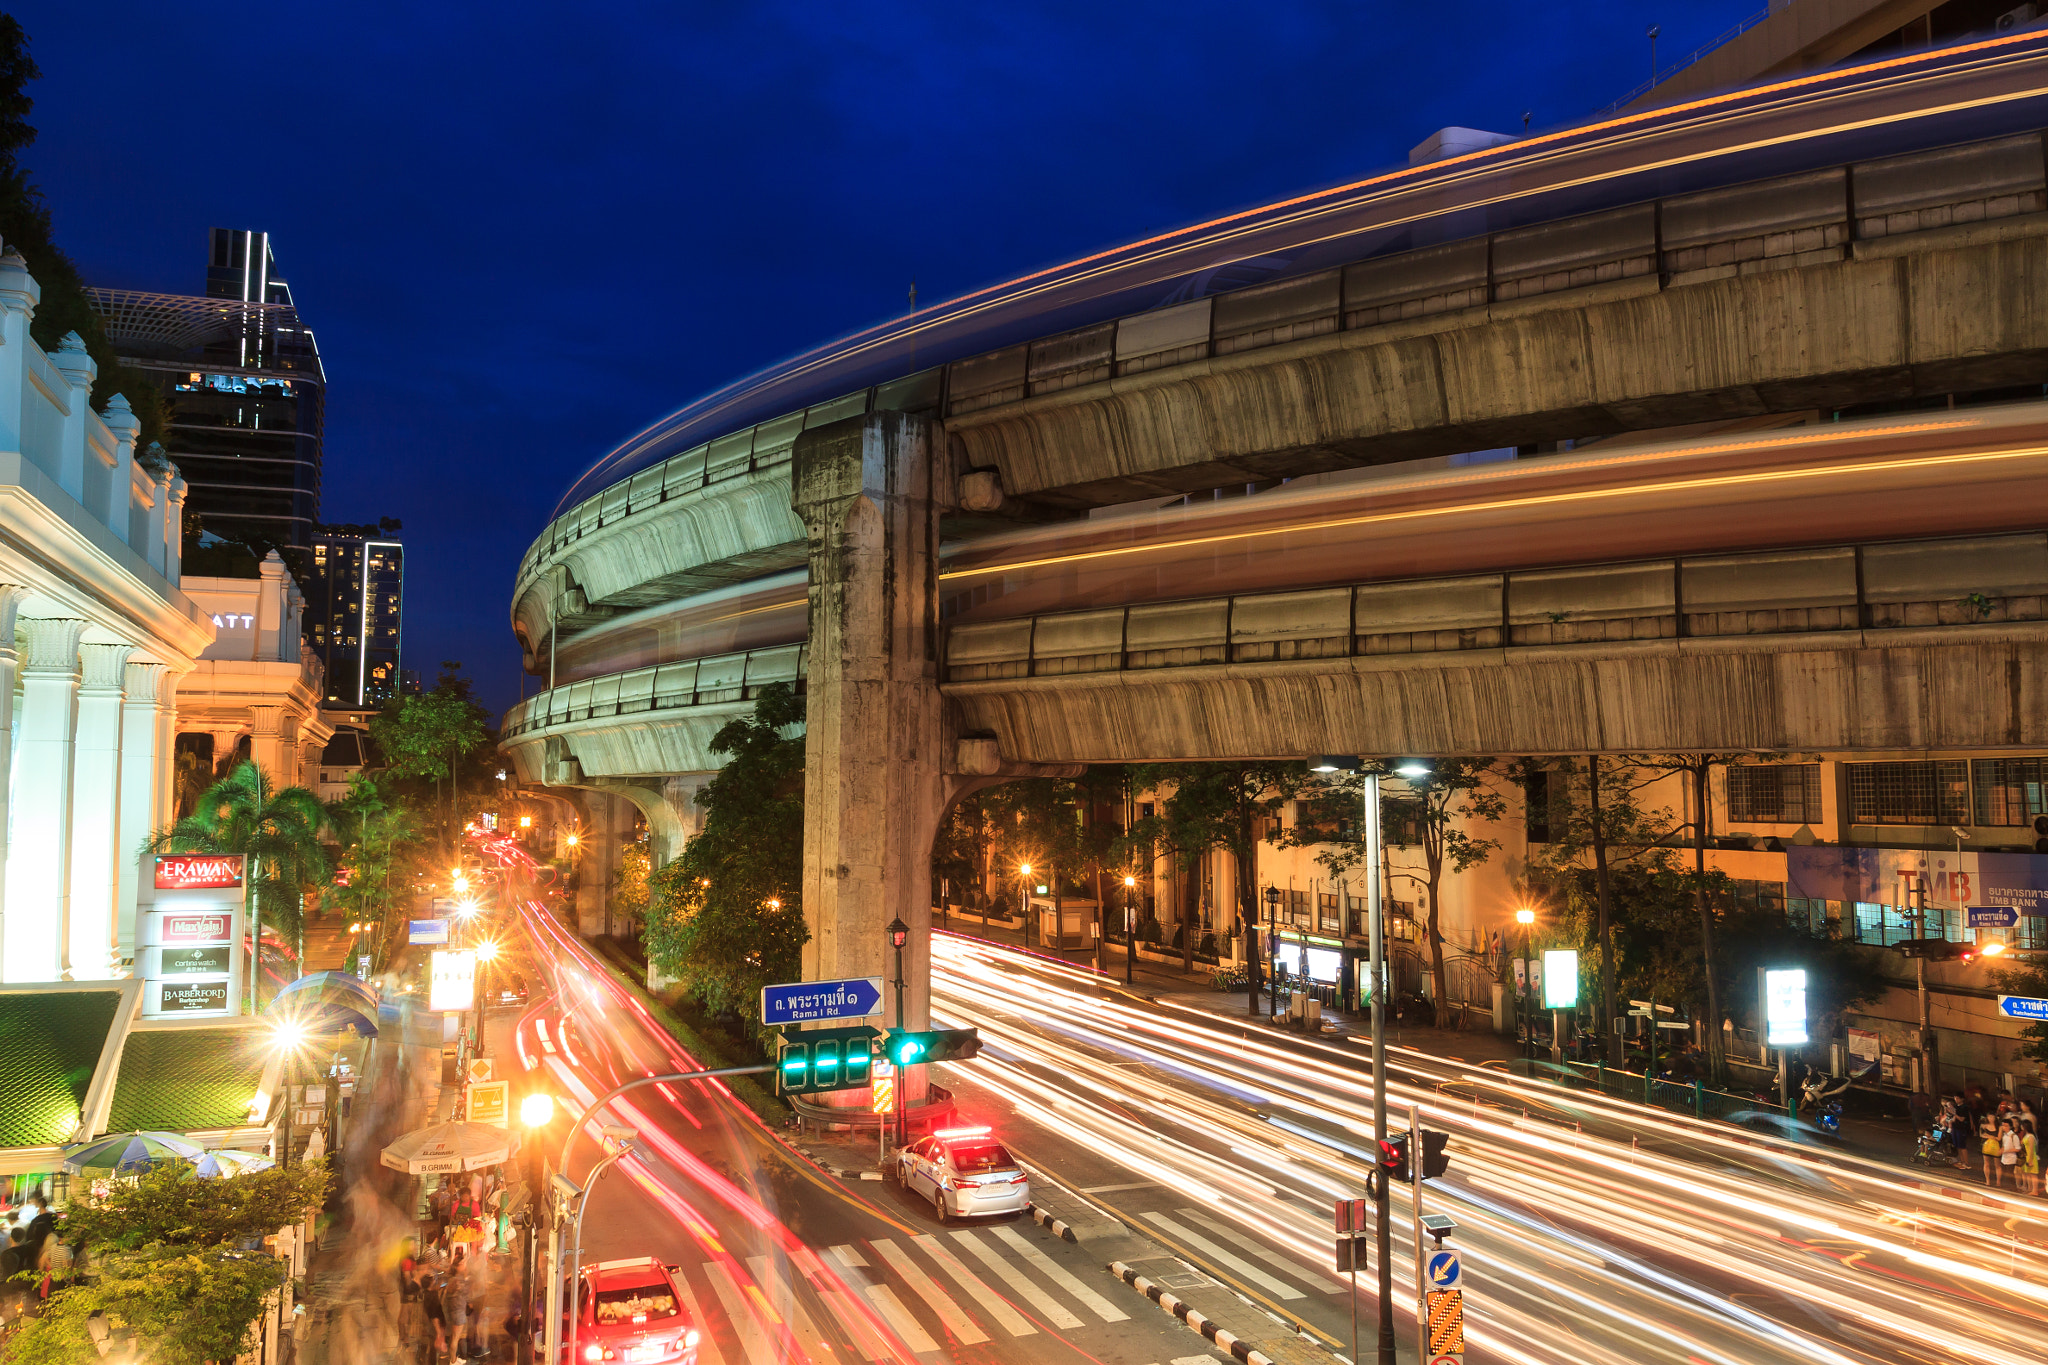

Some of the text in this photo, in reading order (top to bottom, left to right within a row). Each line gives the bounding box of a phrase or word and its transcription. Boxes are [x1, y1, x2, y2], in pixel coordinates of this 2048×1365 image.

[163, 861, 235, 878] ERAWAN
[1897, 870, 1972, 902] TMB
[1989, 896, 2038, 907] TMB BANK
[175, 917, 220, 933] MaxValu
[163, 989, 226, 1001] BARBERFORD
[792, 1010, 818, 1019] Rama
[826, 1007, 841, 1017] Rd.
[421, 1163, 453, 1172] B.GRIMM
